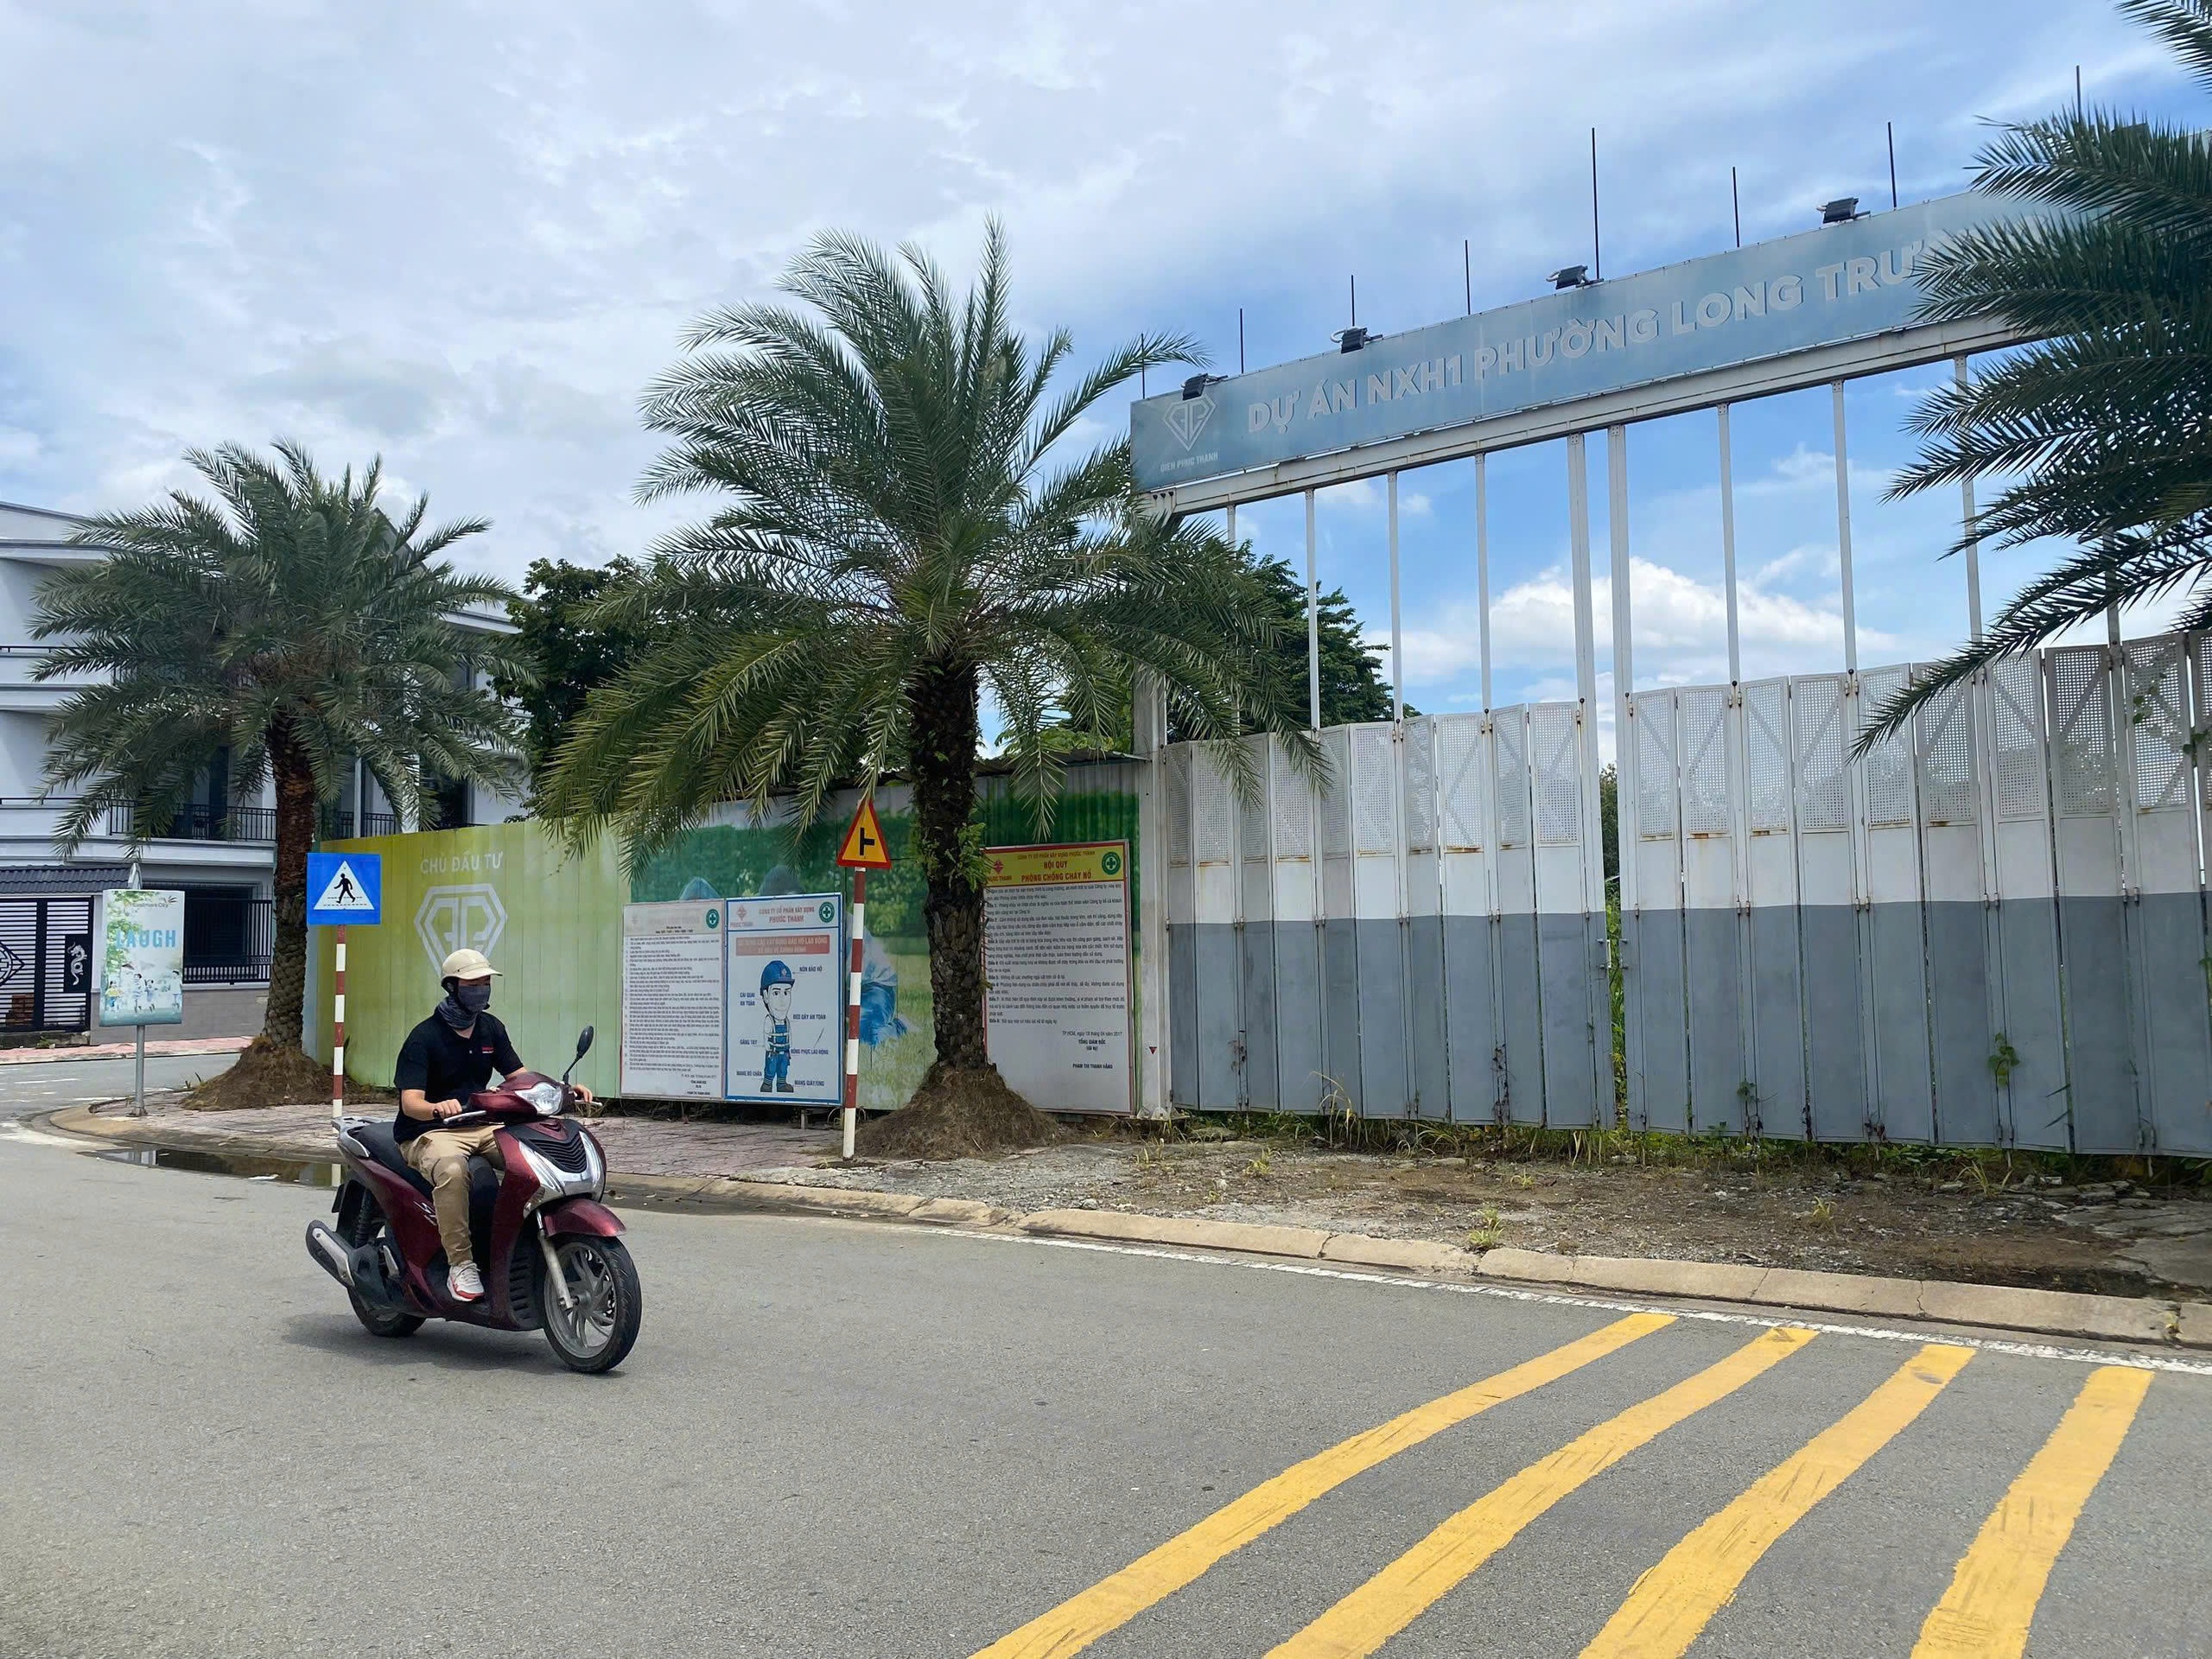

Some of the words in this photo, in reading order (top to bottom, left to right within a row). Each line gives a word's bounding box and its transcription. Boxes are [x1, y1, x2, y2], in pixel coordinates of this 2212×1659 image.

[1248, 391, 1300, 435] DỰ
[1307, 378, 1357, 420] ÁN
[1368, 354, 1462, 405] NXH1
[1474, 309, 1658, 380] PHƯỜNG
[1671, 276, 1803, 336] LONG
[420, 854, 447, 874] CHỦ
[451, 850, 480, 872] ĐẦU
[484, 851, 504, 869] TƯ
[1043, 860, 1054, 869] NỘI
[1055, 861, 1068, 869] QUY
[1021, 872, 1042, 882] PHÒNG
[1043, 870, 1065, 881] CHỐNG
[1065, 871, 1081, 880] CHÁY
[1083, 868, 1092, 880] NỔ
[116, 930, 176, 949] LAUGH
